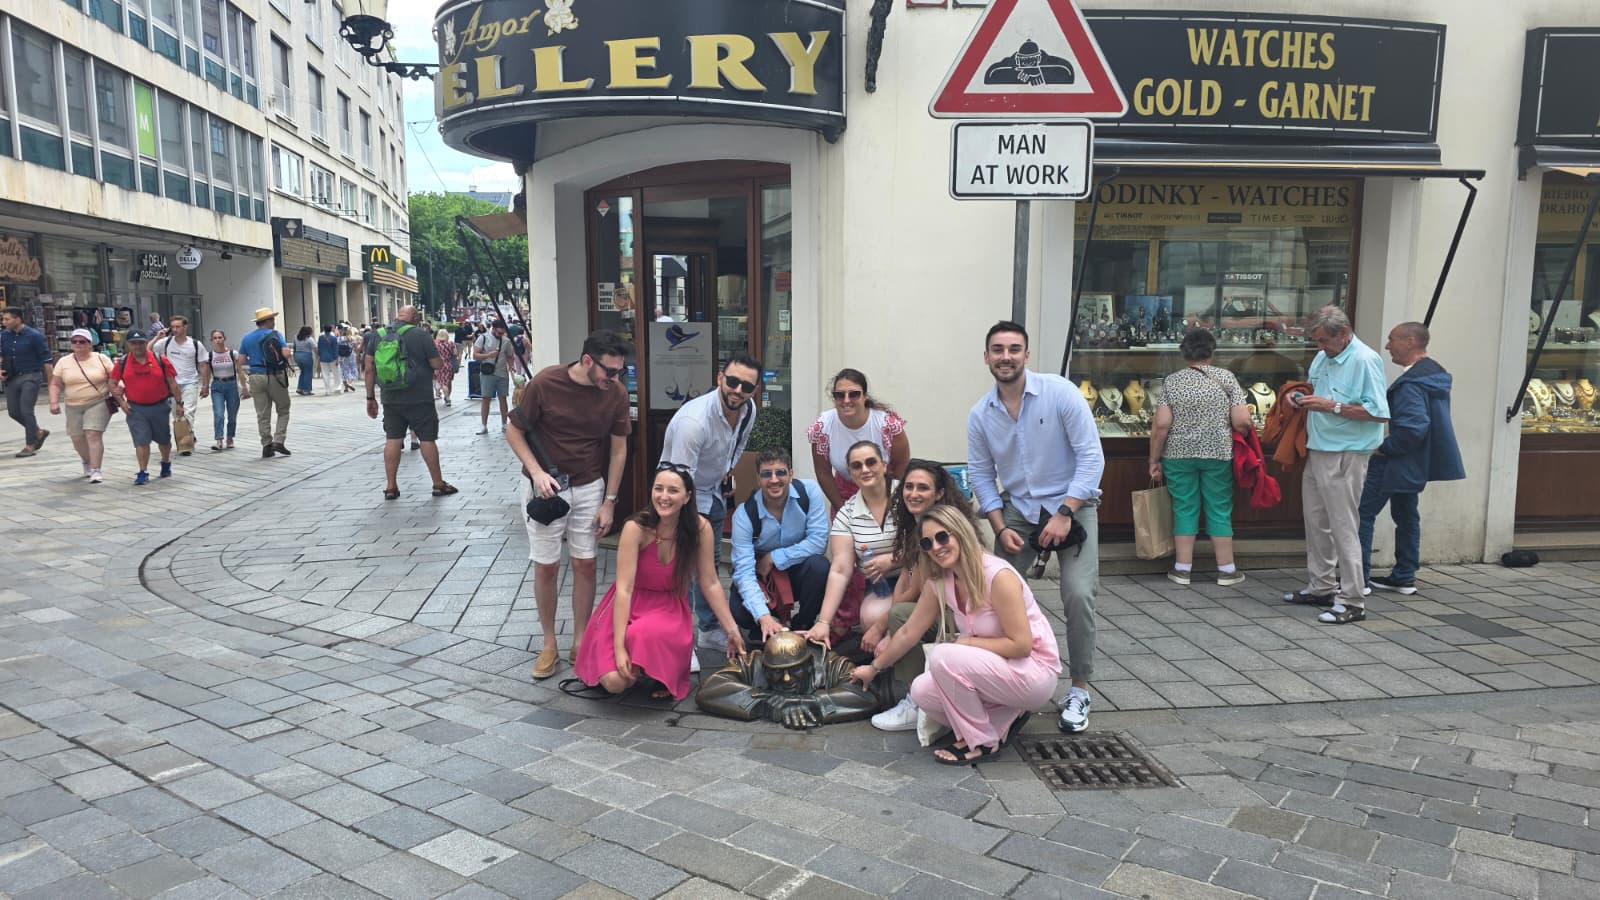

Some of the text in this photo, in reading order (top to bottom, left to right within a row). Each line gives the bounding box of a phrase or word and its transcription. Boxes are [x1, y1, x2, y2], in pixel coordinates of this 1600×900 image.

[443, 5, 541, 65] Amor
[1187, 28, 1336, 70] WATCHES
[1133, 78, 1222, 116] GOLD
[1258, 80, 1376, 121] GARNET
[998, 134, 1047, 155] MAN
[970, 164, 1069, 185] AT WORK
[1227, 184, 1349, 207] WATCHES
[1250, 214, 1287, 222] TIMEX
[149, 254, 168, 267] DELIA
